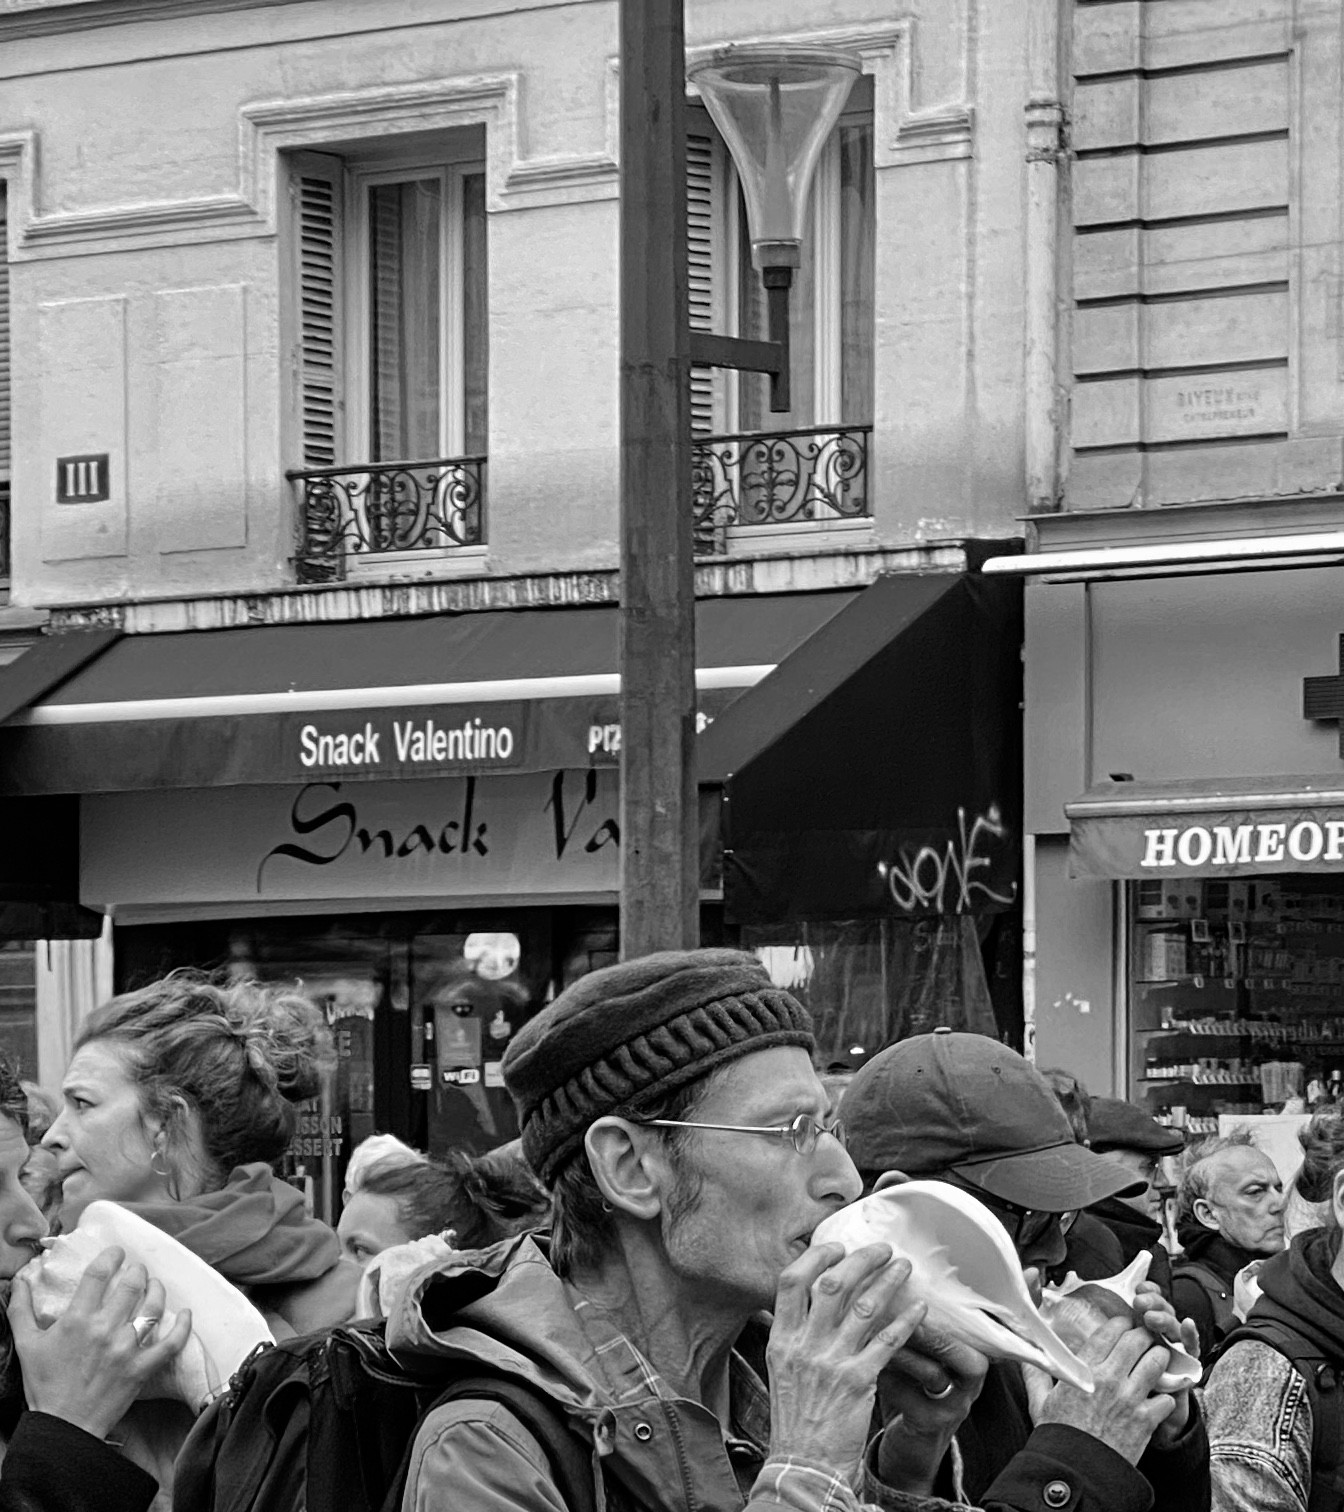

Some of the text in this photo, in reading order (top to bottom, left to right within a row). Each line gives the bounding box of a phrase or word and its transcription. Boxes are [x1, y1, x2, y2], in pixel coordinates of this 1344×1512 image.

[66, 461, 100, 496] 111
[300, 717, 514, 767] Snack Valentino
[257, 774, 489, 893] Snack
